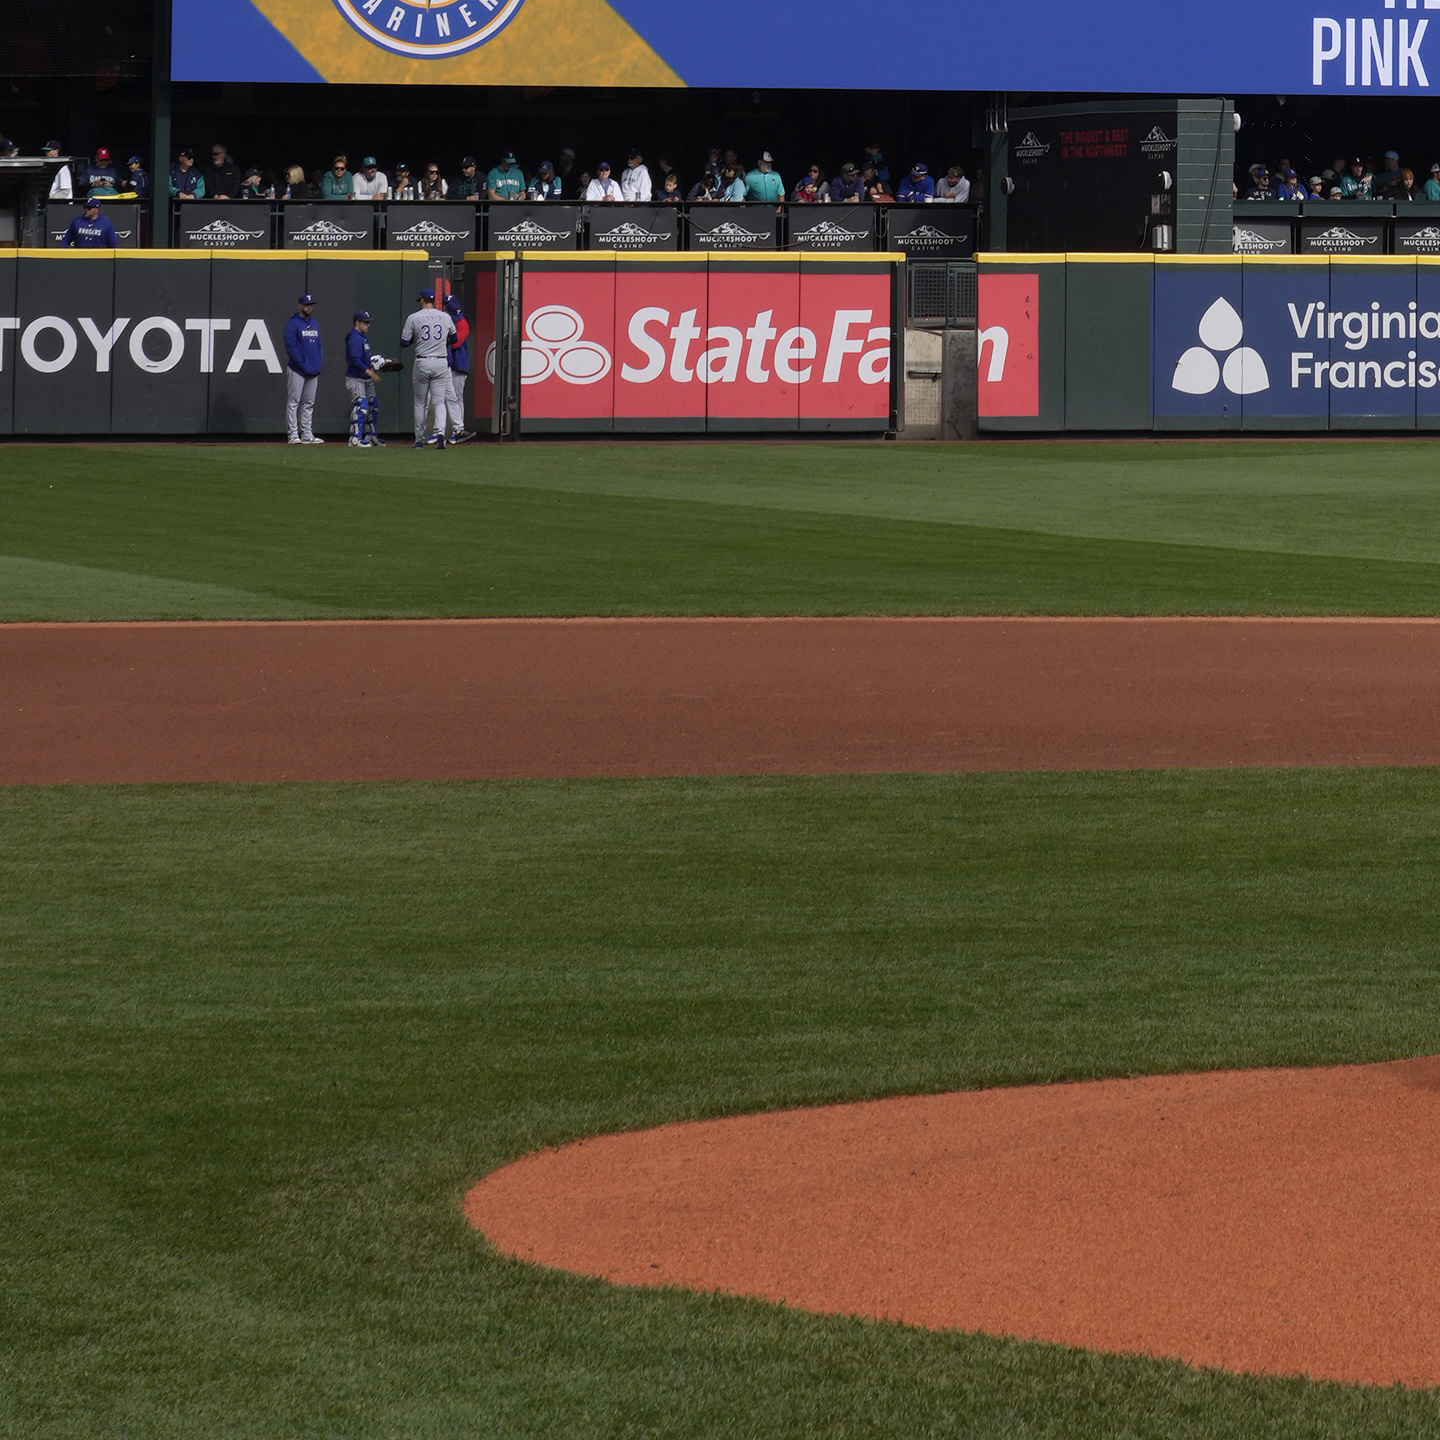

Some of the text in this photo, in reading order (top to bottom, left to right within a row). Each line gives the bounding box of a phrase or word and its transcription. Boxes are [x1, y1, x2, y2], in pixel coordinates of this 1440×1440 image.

[1312, 17, 1430, 87] PINK
[1060, 130, 1073, 143] THE
[1075, 130, 1101, 143] BIGGEST
[1112, 128, 1129, 141] BEST
[1061, 144, 1127, 158] IN THE NORTHWEST
[1141, 143, 1171, 152] MUCKLESHOOT
[1016, 149, 1044, 158] MUCKLESHOOT
[189, 233, 250, 241] MUCKLESHOOT
[292, 234, 353, 242] MUCKLESHOOT
[395, 234, 455, 242] MUCKLESHOOT
[421, 324, 443, 341] 33
[621, 305, 817, 385] State
